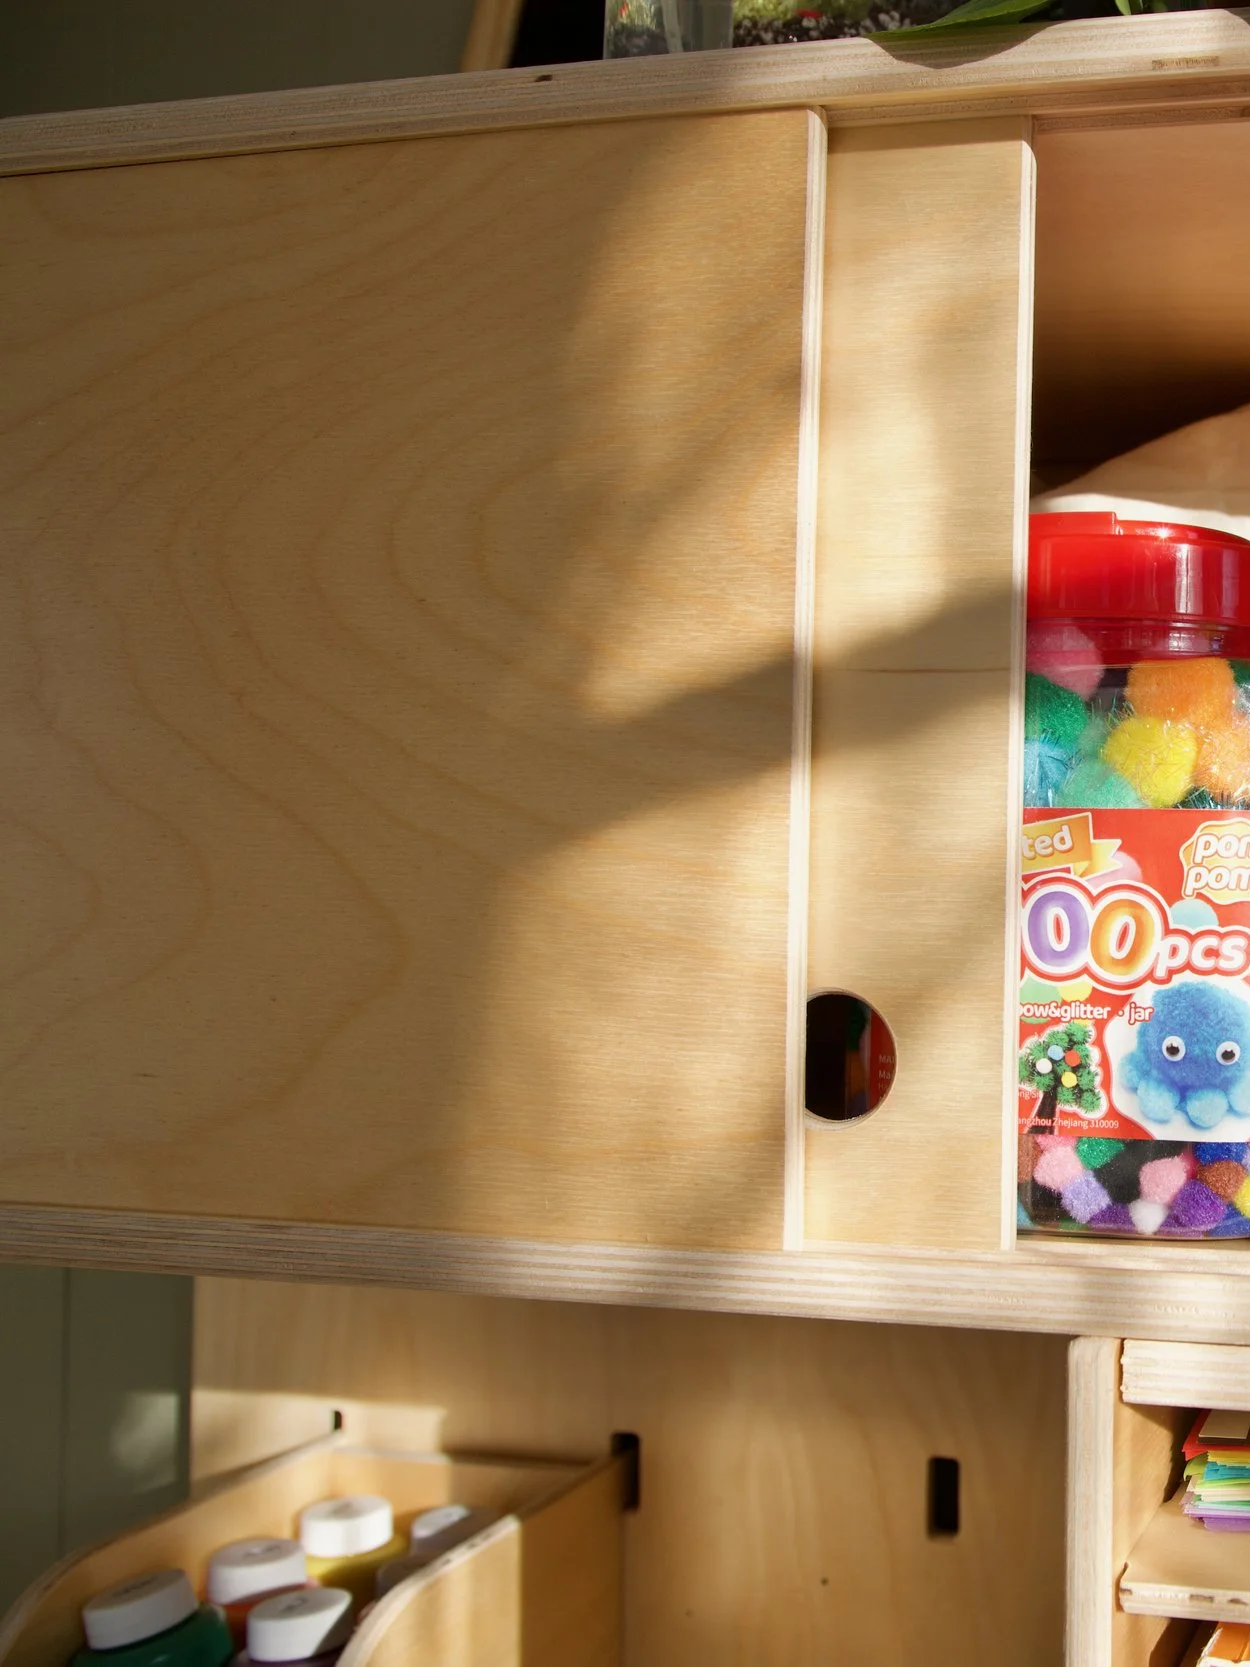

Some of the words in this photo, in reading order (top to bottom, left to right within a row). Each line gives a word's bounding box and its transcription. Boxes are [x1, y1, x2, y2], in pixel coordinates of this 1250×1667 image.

[1128, 1002, 1153, 1024] jar
[1052, 1118, 1088, 1130] Zhejiang
[1089, 1120, 1119, 1129] 310009
